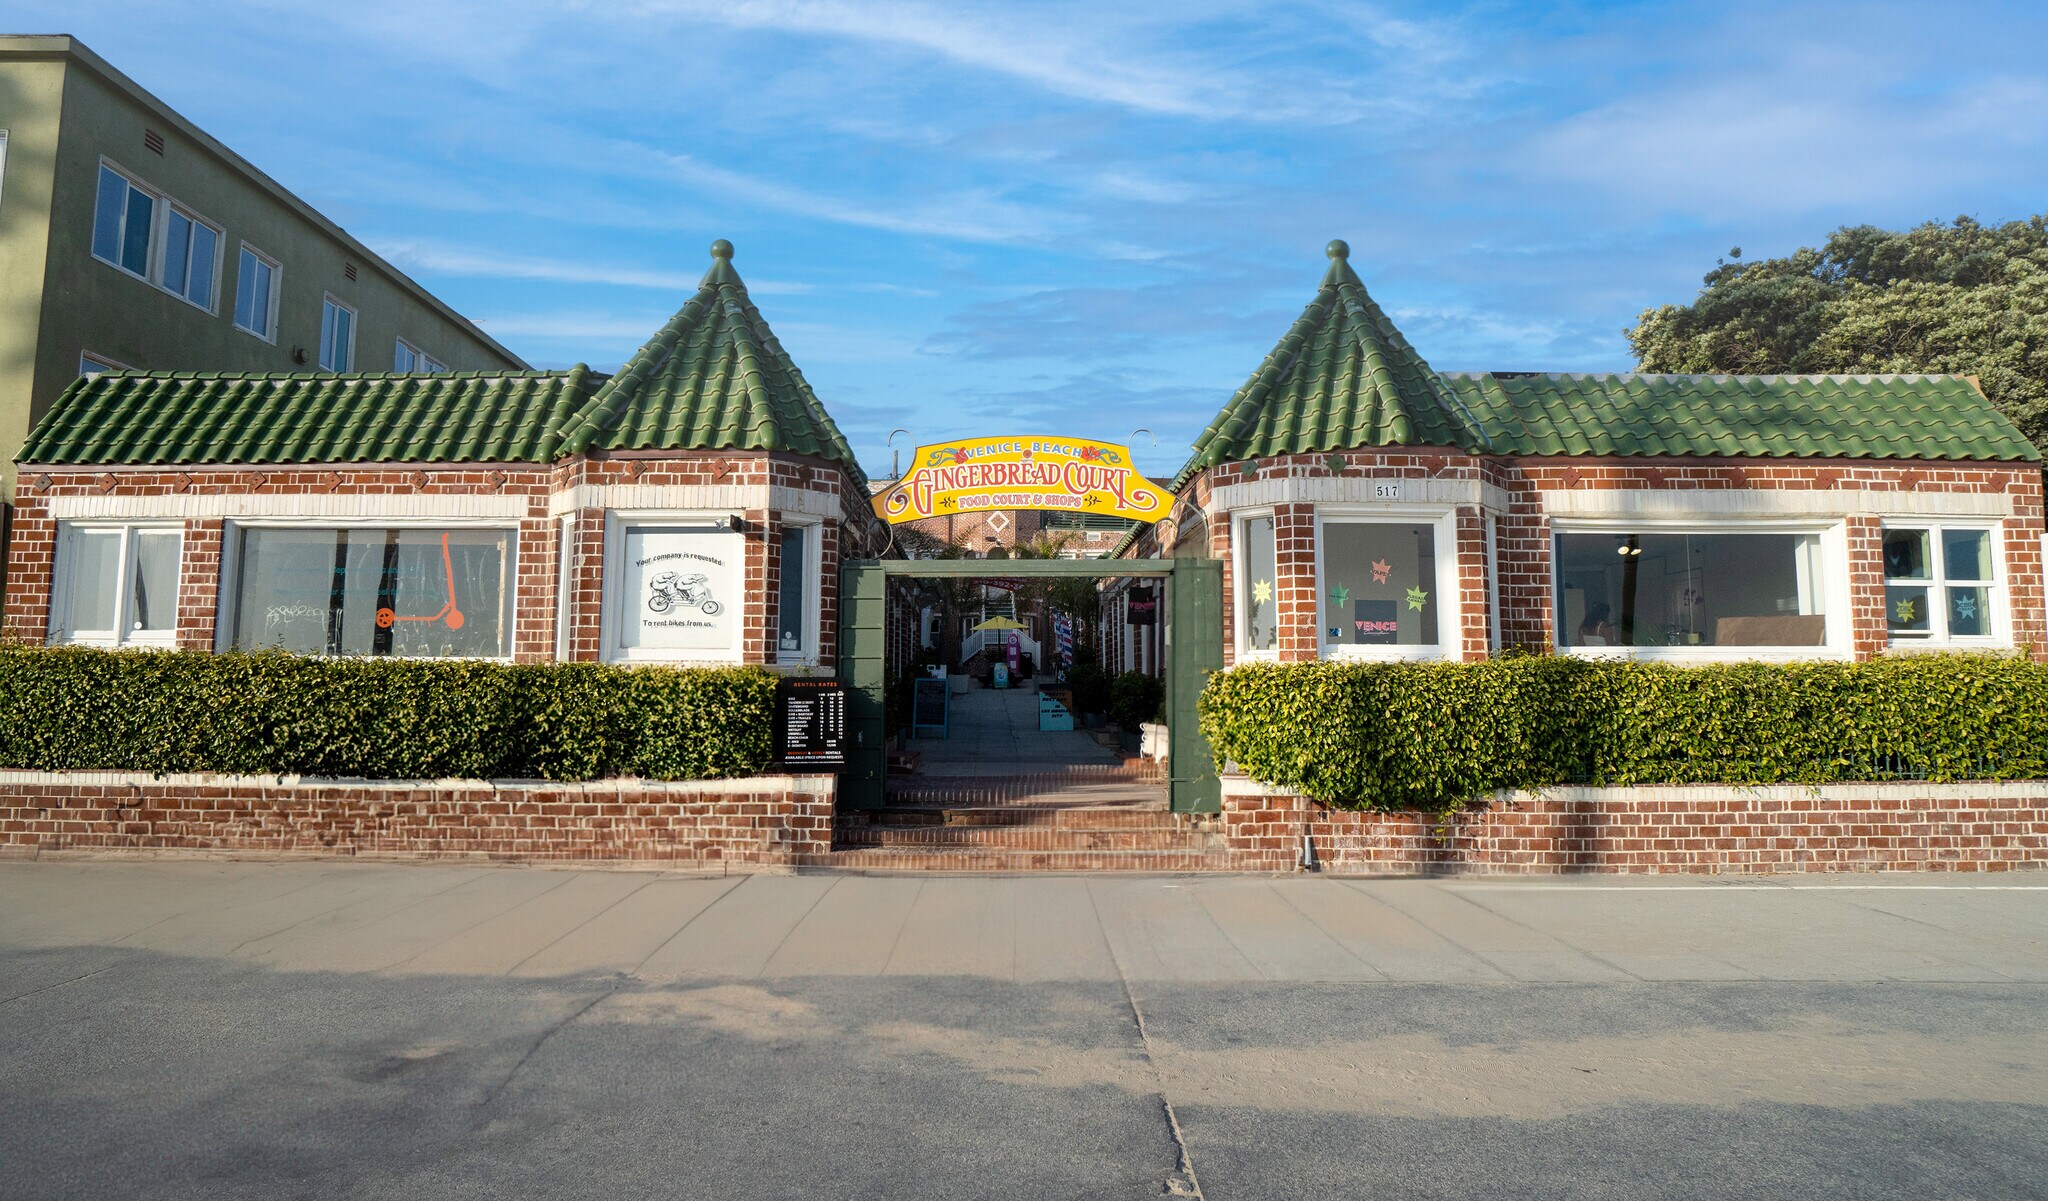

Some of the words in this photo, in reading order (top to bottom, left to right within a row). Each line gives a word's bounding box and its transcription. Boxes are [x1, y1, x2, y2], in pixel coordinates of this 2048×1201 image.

[965, 441, 1022, 459] VENICE
[1032, 442, 1082, 458] BEACH
[884, 461, 1061, 516] GINGERBREAD
[1063, 461, 1158, 512] COURT
[1376, 486, 1399, 497] 517
[958, 495, 991, 509] FOOD
[991, 494, 1031, 507] COURT
[1032, 494, 1044, 506] &
[1044, 494, 1082, 508] SHOPS
[635, 557, 652, 568] Your
[653, 552, 682, 562] company
[642, 619, 652, 627] To
[653, 619, 667, 627] rent
[668, 619, 685, 627] bikes
[686, 619, 703, 627] from
[1354, 621, 1398, 631] VENICE
